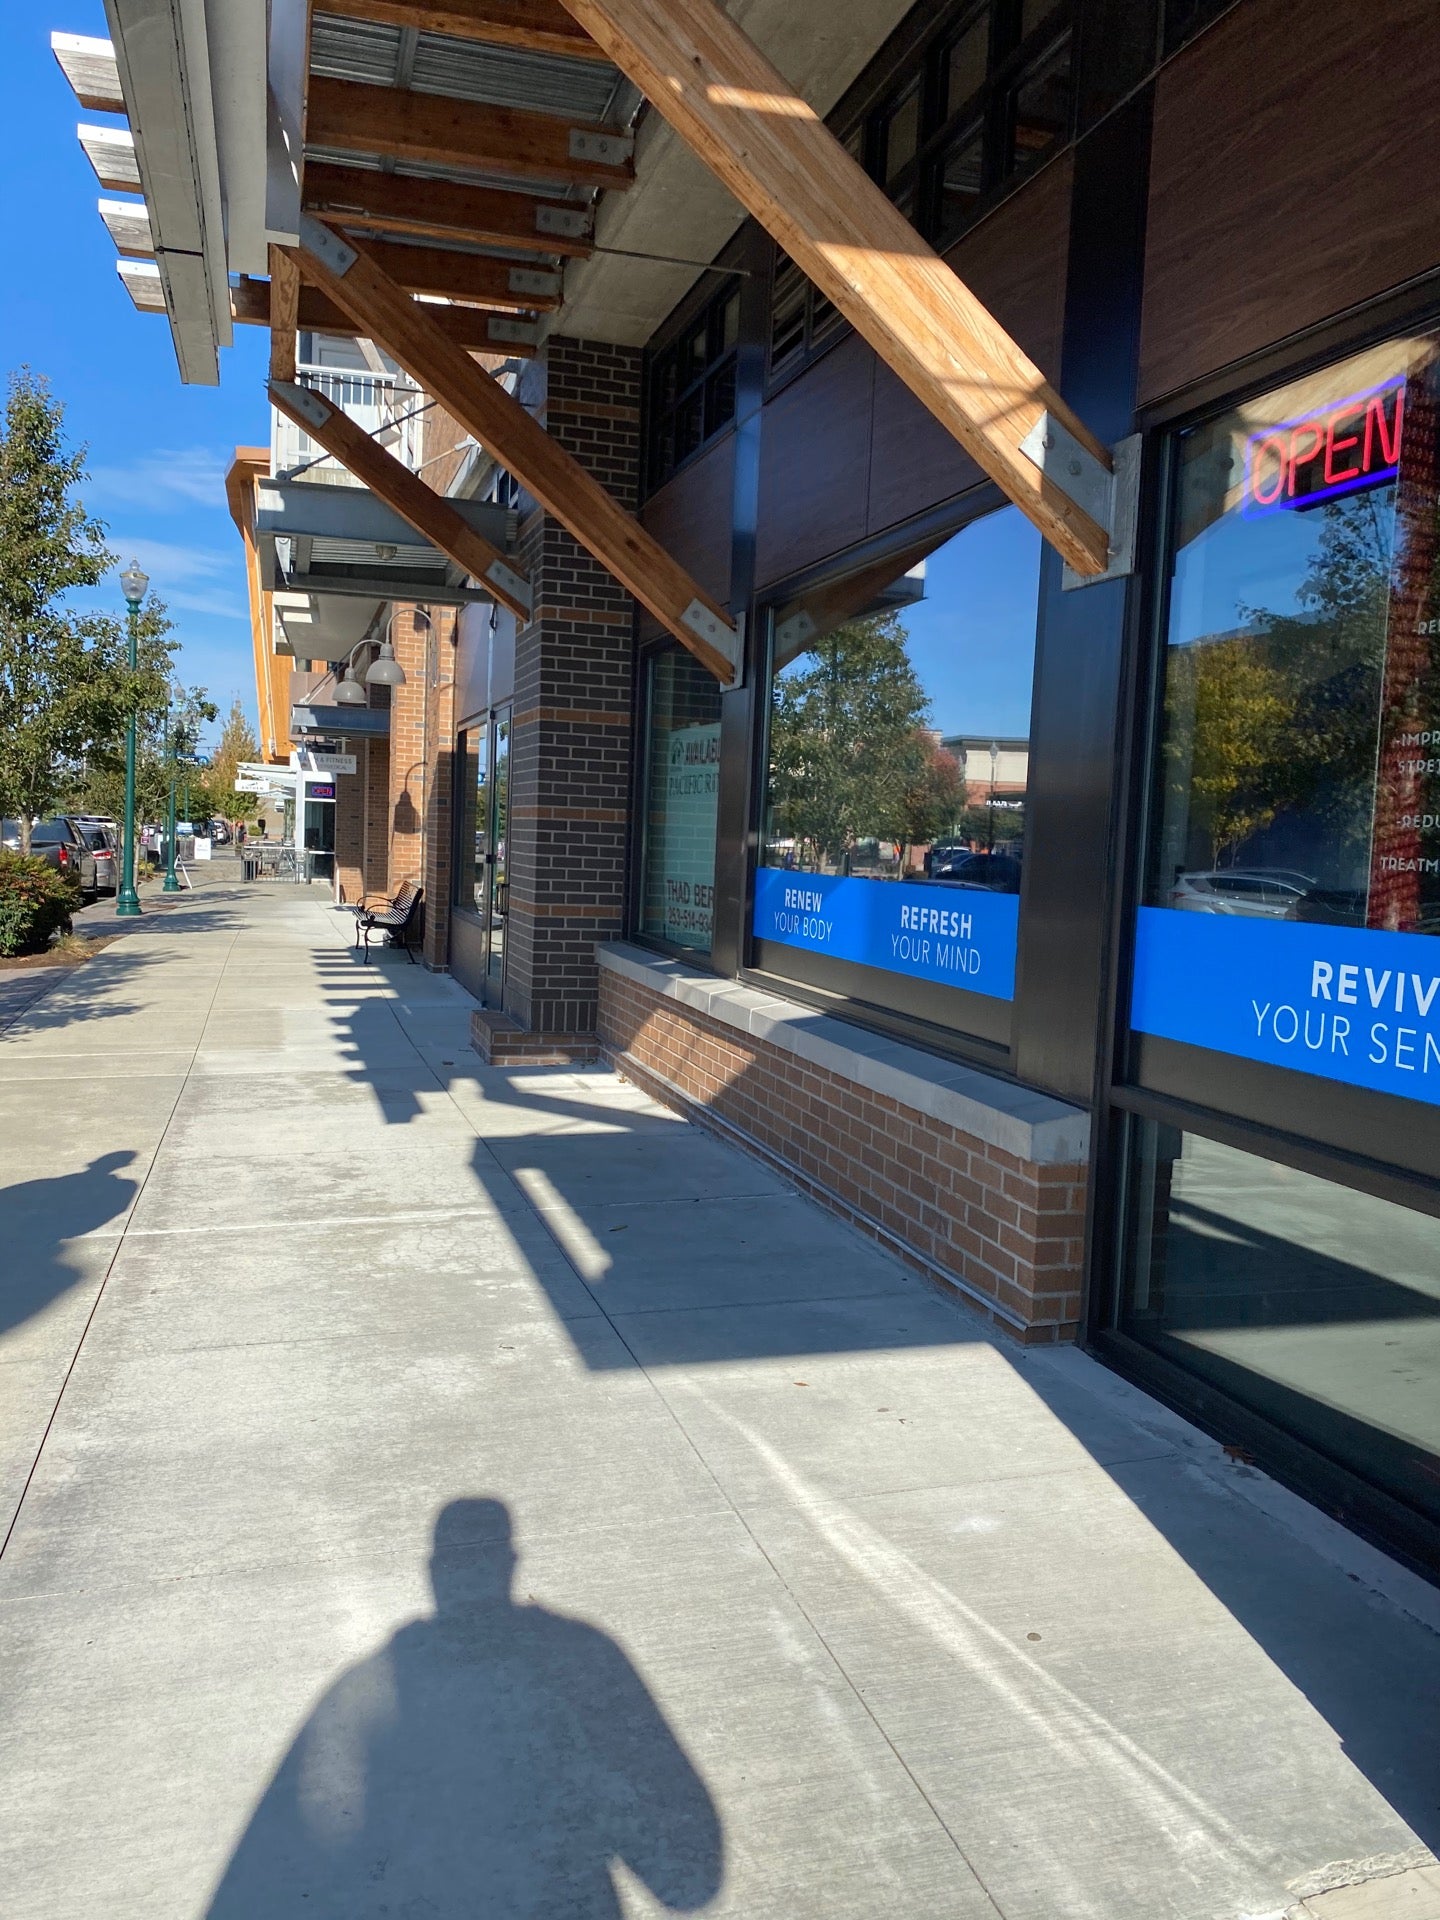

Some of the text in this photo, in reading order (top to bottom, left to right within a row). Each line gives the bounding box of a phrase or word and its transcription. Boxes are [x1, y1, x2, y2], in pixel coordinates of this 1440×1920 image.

[1252, 387, 1404, 505] OPEN
[667, 879, 690, 904] THAD
[784, 888, 823, 912] RENEW
[774, 911, 833, 943] YOUR BODY
[901, 904, 973, 940] REFRESH
[891, 933, 981, 975] YOUR MIND
[1311, 960, 1440, 1017] REVIV
[1252, 1000, 1350, 1056] YOUR
